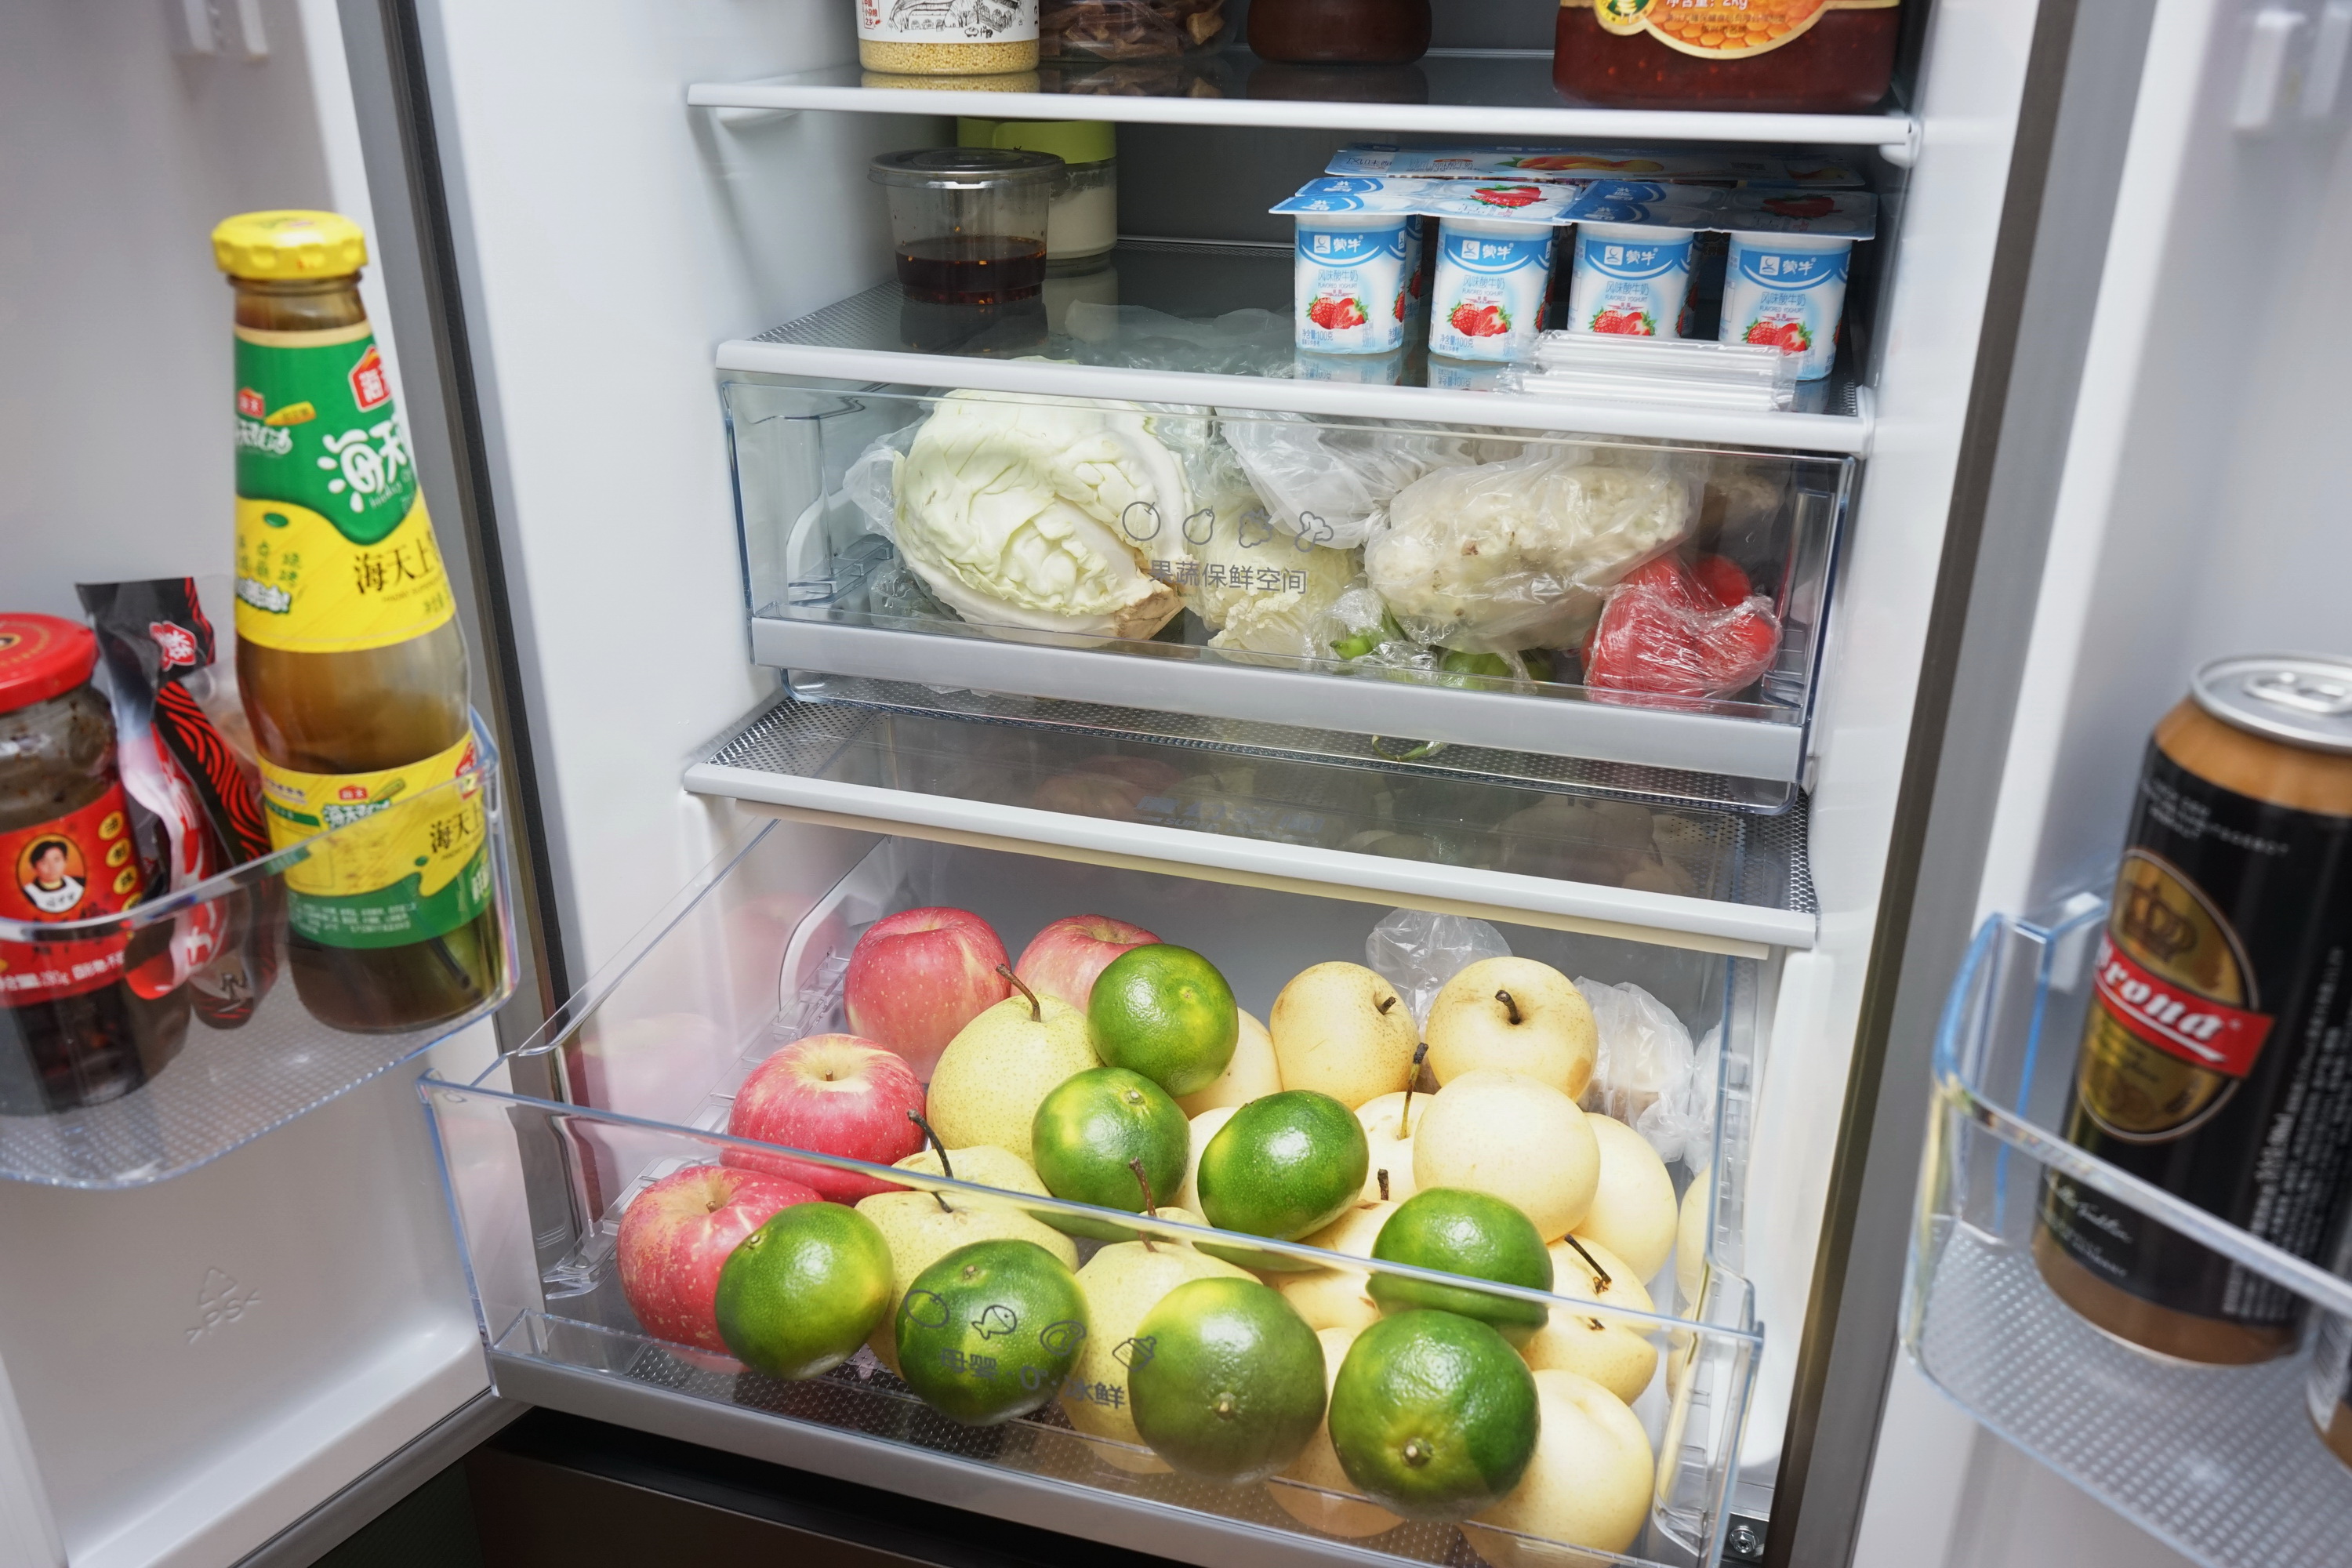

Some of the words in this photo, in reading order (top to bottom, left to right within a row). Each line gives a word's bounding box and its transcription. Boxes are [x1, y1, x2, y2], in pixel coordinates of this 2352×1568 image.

[1333, 238, 1361, 253] 蒙牛
[1482, 244, 1512, 260] 蒙牛
[1625, 249, 1656, 266] 蒙牛
[1782, 260, 1814, 275] 蒙牛
[1317, 270, 1358, 282] 风味酸牛奶
[1463, 275, 1505, 290] 风味酸牛奶
[1606, 281, 1650, 296] 风味酸牛奶
[1761, 292, 1806, 307] 风味酸牛奶
[1149, 560, 1307, 593] 果蔬保鲜空间
